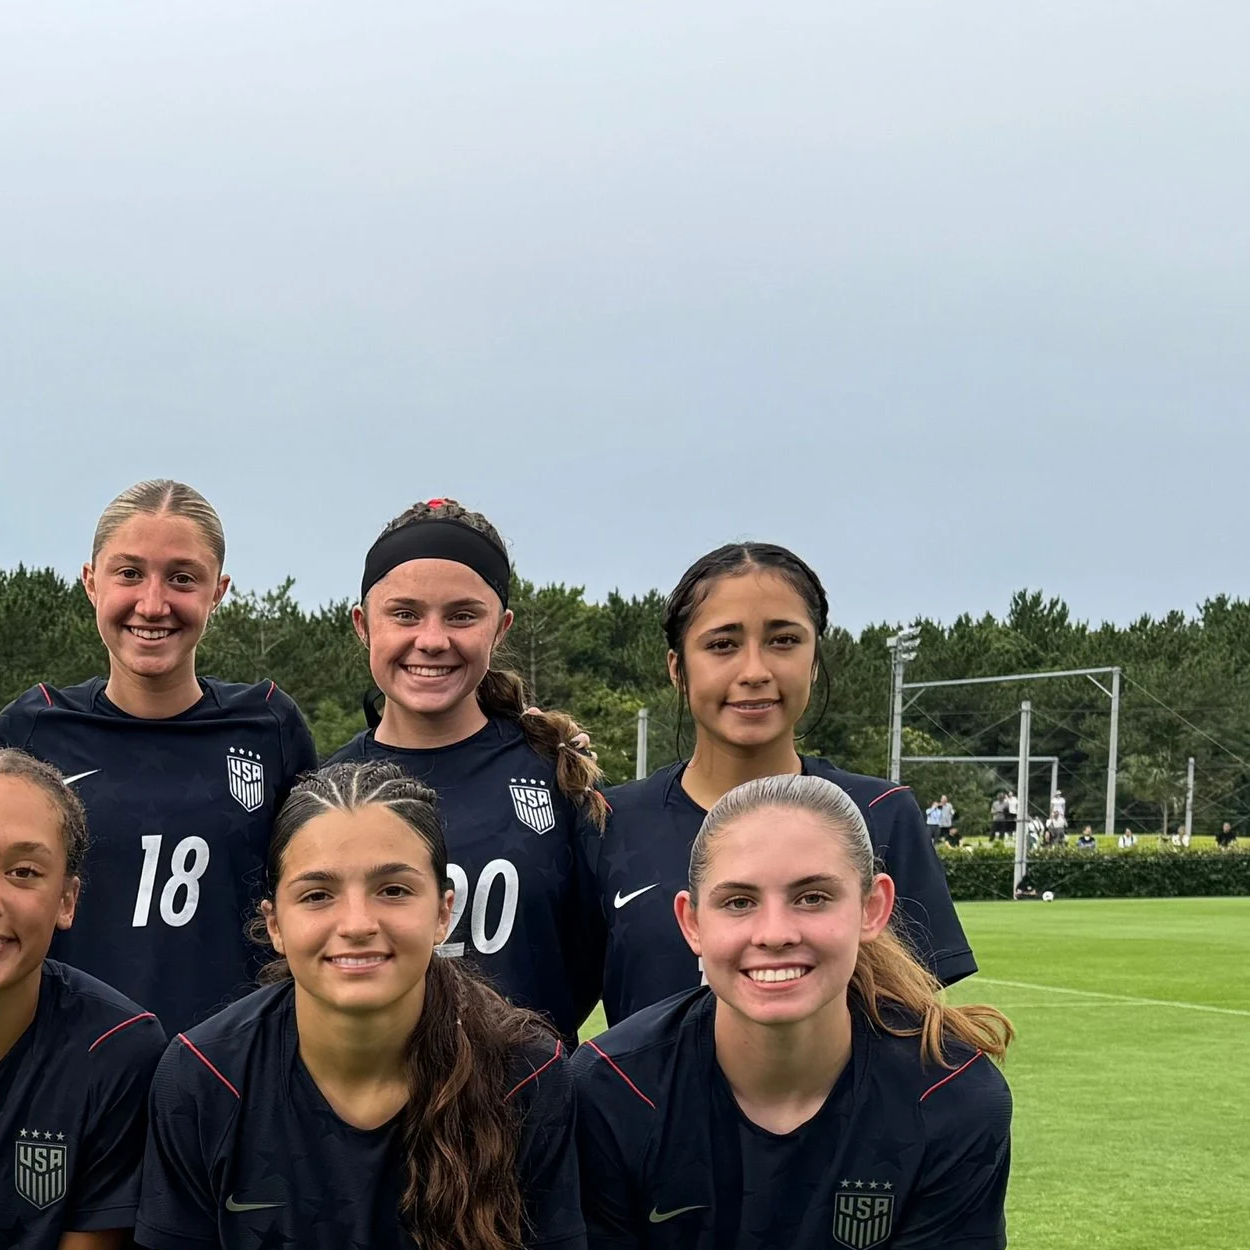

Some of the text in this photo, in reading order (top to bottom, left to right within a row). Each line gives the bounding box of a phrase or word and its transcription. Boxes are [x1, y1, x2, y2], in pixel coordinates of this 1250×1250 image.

[230, 759, 261, 782] USA
[513, 788, 548, 808] USA
[132, 834, 210, 928] 18
[433, 858, 519, 958] 20
[19, 1146, 63, 1173] USA
[839, 1196, 890, 1220] USA
